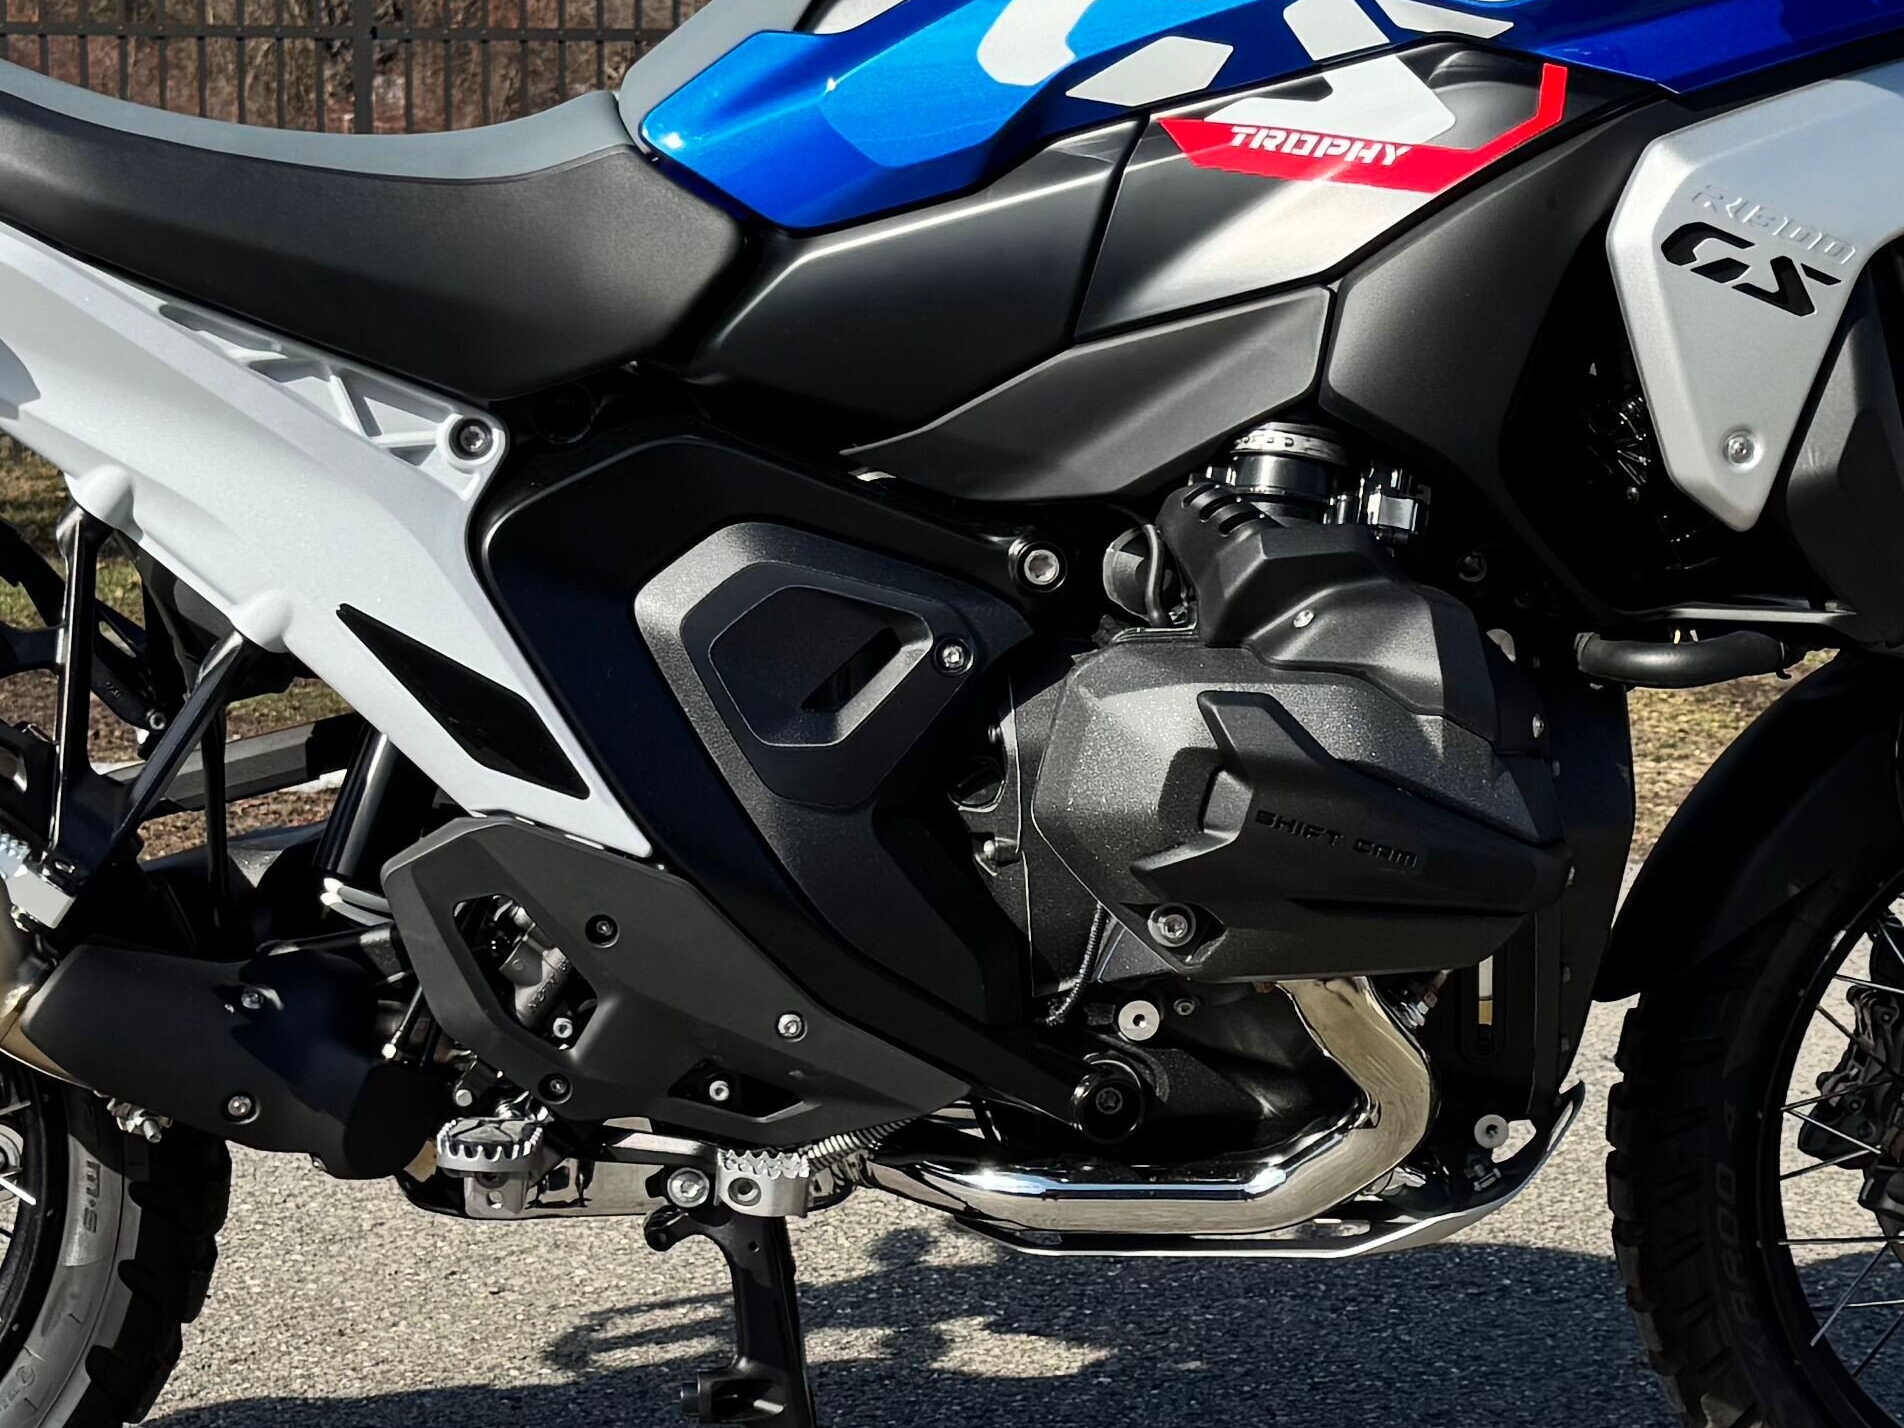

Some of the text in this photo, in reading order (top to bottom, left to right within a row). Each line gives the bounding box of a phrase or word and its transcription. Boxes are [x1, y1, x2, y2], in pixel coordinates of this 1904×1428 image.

[1230, 125, 1413, 166] TROPHY
[1660, 221, 1843, 317] GS
[1255, 809, 1419, 869] SHIFT CAM
